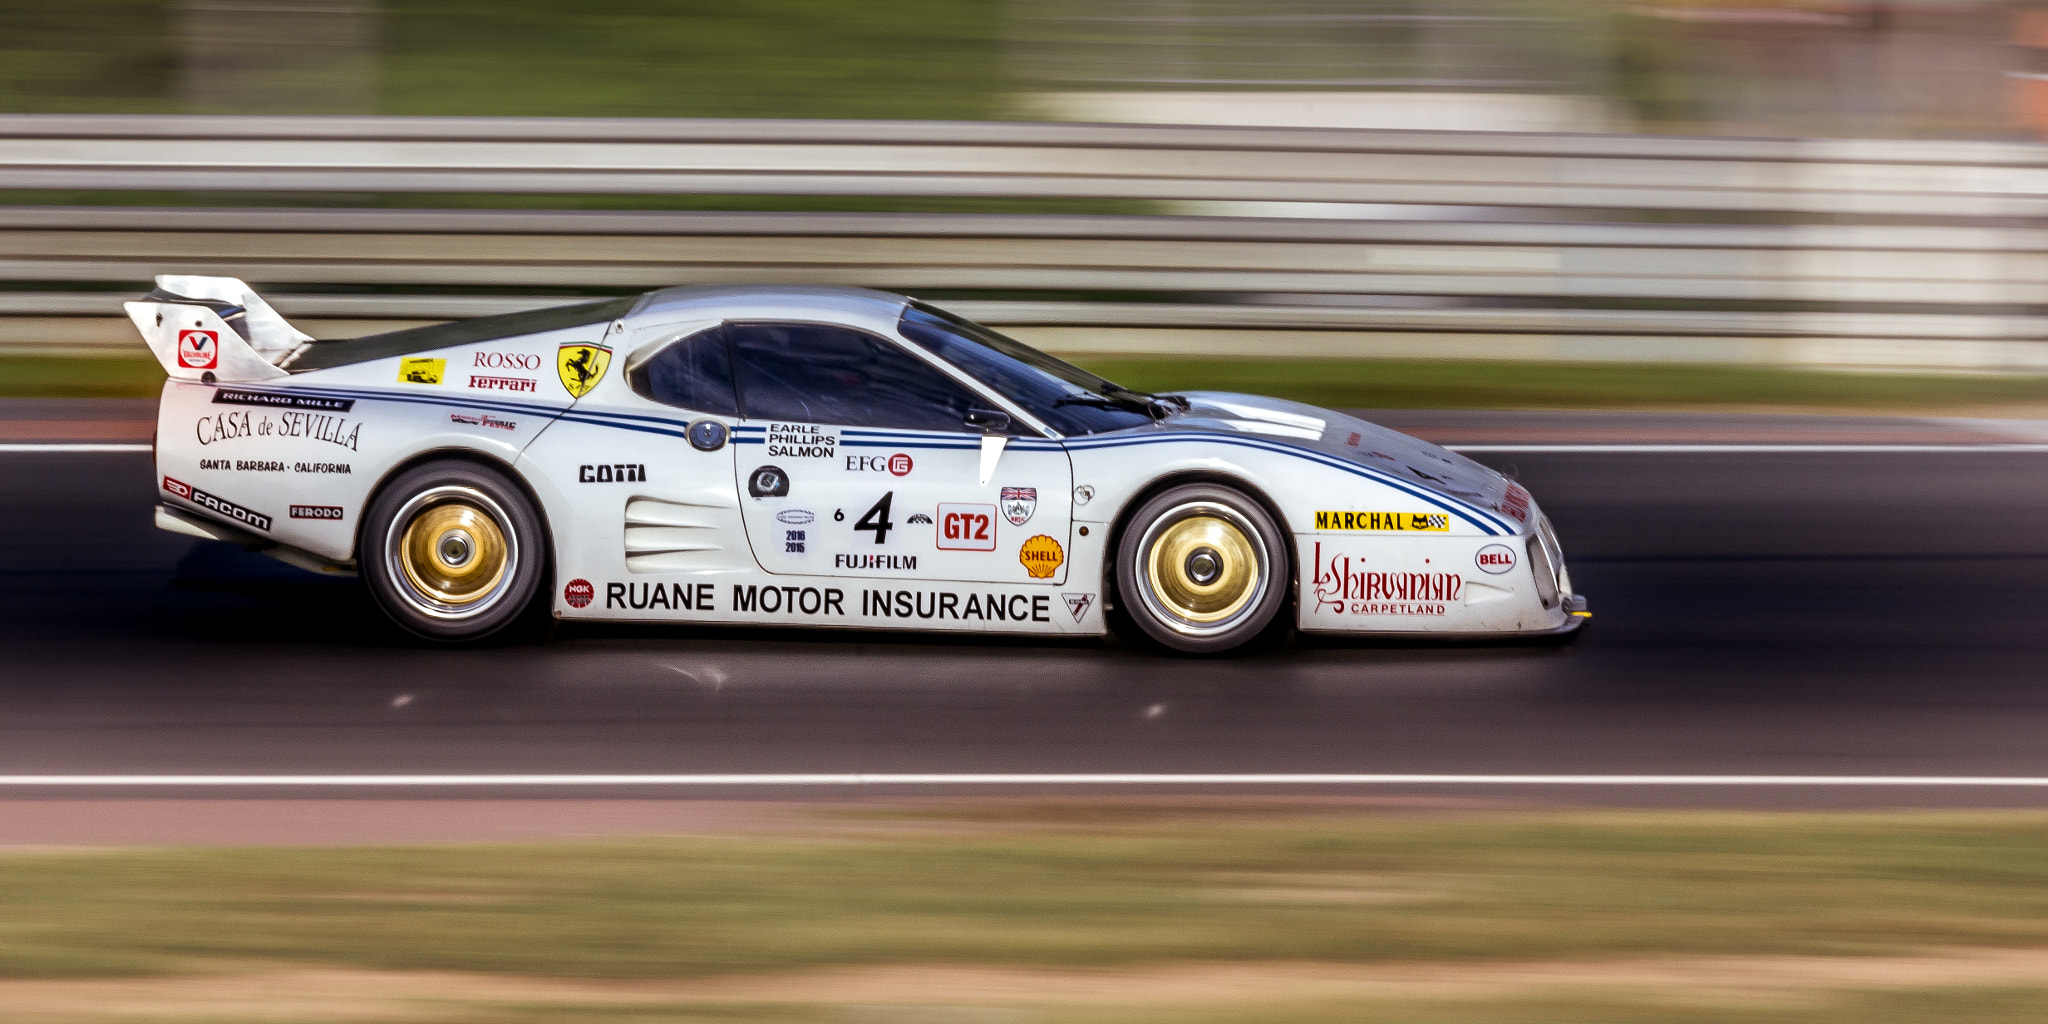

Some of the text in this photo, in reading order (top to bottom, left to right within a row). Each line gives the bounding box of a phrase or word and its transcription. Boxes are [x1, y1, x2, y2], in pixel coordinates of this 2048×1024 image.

[473, 351, 541, 370] ROSSO
[468, 375, 537, 393] Ferrari
[222, 392, 345, 408] RICHARD MILLE
[196, 410, 363, 452] CASA de SEVILLA
[770, 423, 821, 434] EARLE
[769, 433, 835, 446] PHILLIPS
[768, 445, 834, 458] SALMON
[199, 458, 352, 474] SANTA BARBARA CALIFORNIA
[845, 455, 886, 472] EFG
[579, 464, 647, 483] GOTTI
[192, 491, 270, 529] FACOM
[291, 507, 342, 518] FERODO
[833, 508, 845, 522] 6
[853, 491, 893, 544] 4
[944, 512, 989, 540] GT2
[1316, 511, 1404, 530] MARCHAL
[786, 530, 806, 541] 2016
[785, 541, 805, 553] 2015
[835, 554, 917, 570] FUJIFILM
[1025, 550, 1058, 562] SHELL
[1479, 553, 1513, 565] BELL
[568, 584, 590, 593] NGK
[606, 582, 1050, 622] RUANE MOTOR INSURANCE
[1351, 603, 1446, 614] CARPETLAND
